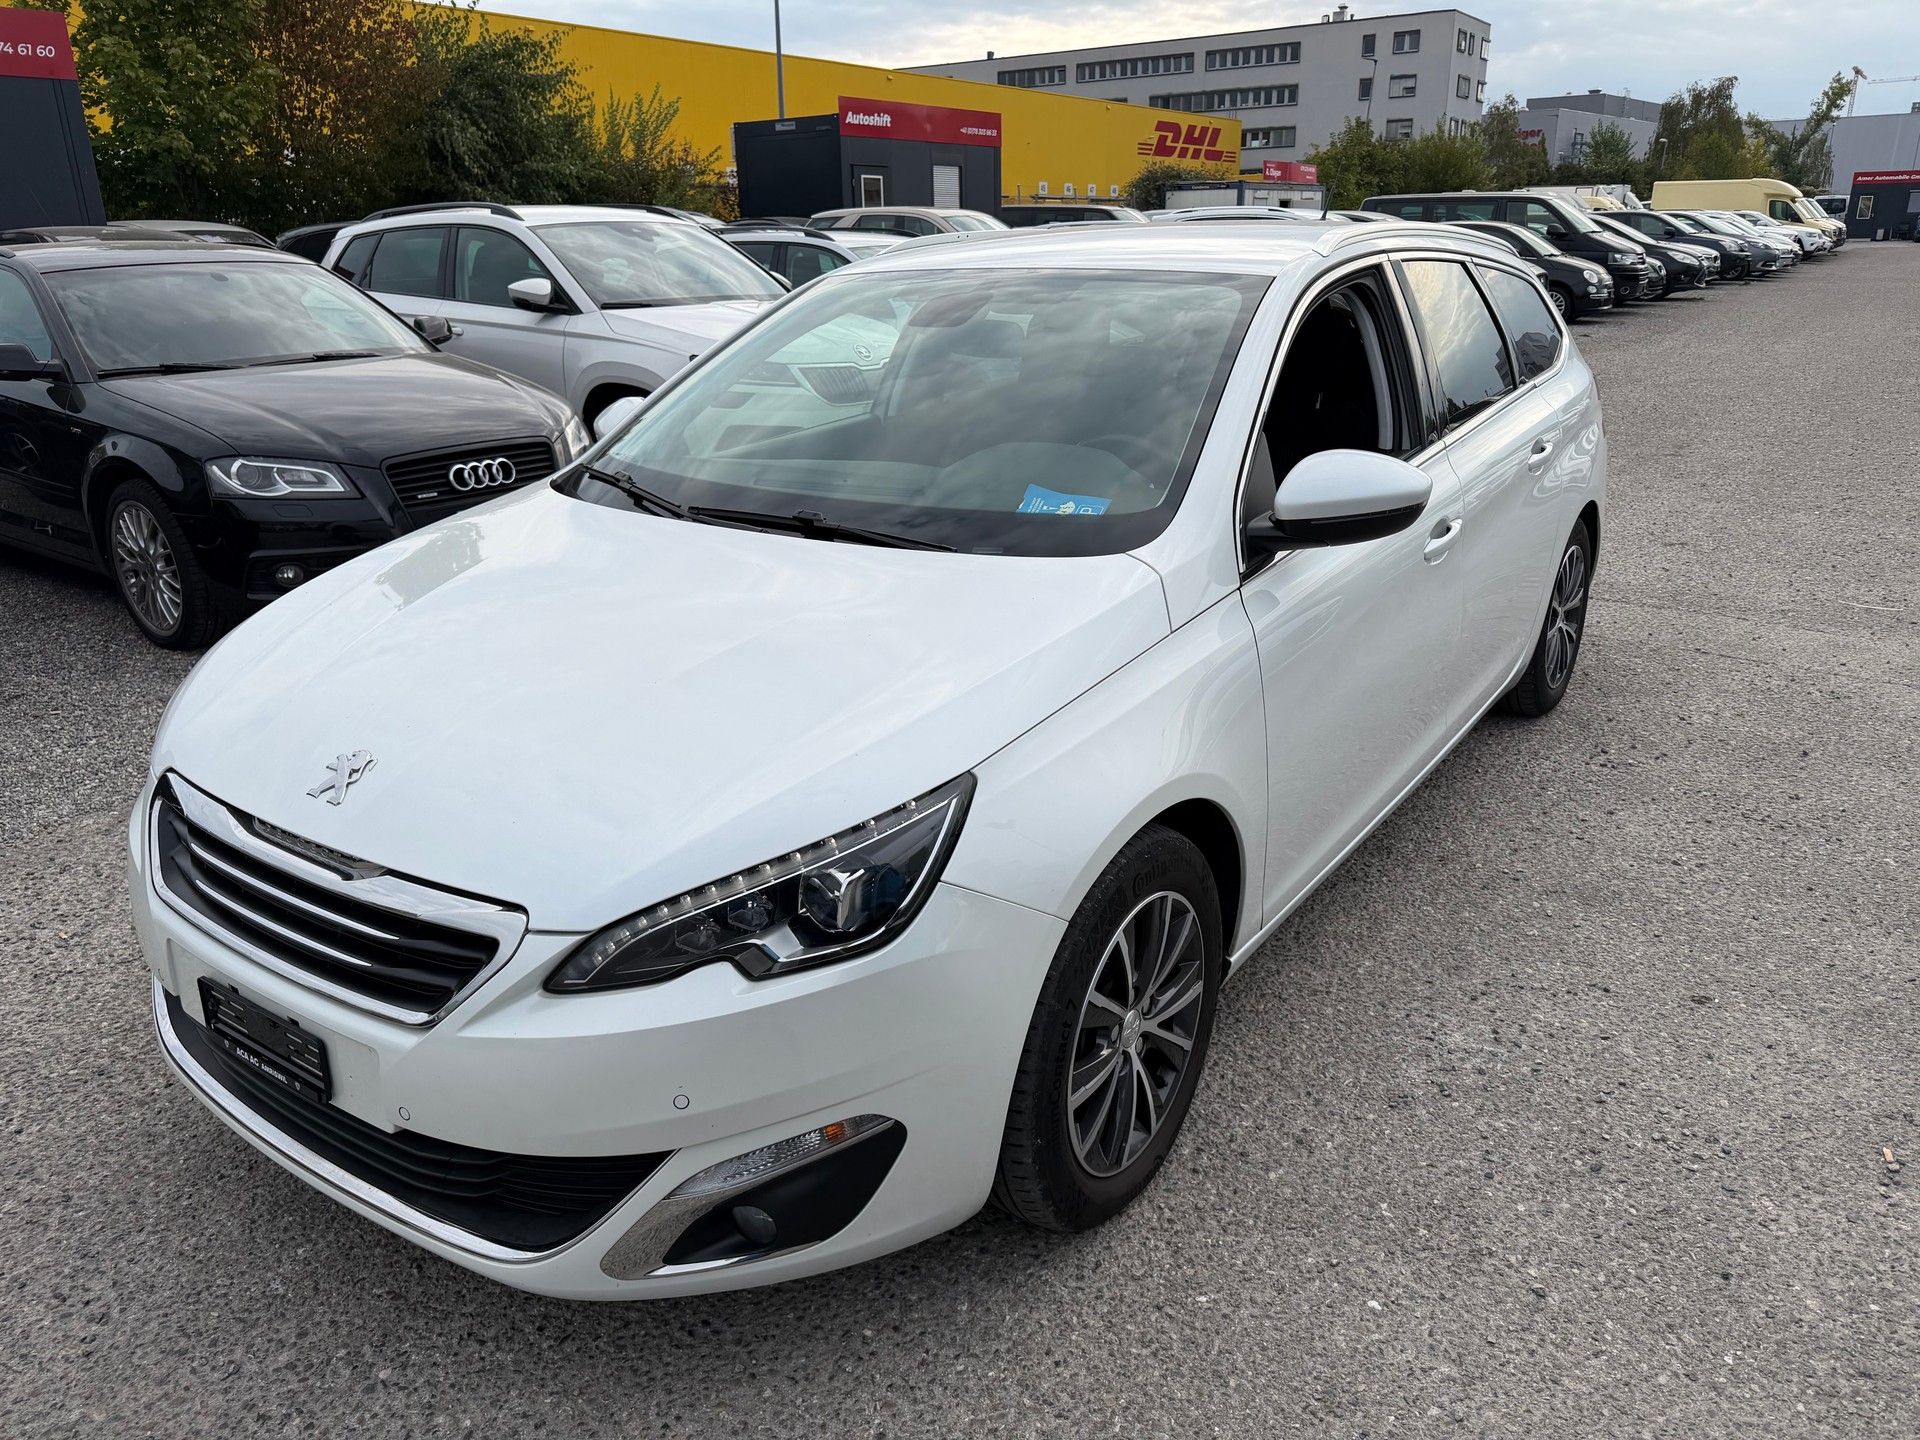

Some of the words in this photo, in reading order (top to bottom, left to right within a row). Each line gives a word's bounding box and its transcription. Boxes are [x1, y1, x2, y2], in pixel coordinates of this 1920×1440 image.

[17, 43, 32, 56] 61
[36, 45, 55, 58] 60
[845, 111, 892, 128] Autoshift
[1152, 120, 1225, 162] DHL
[1517, 128, 1543, 140] iger
[1132, 856, 1192, 899] Continental
